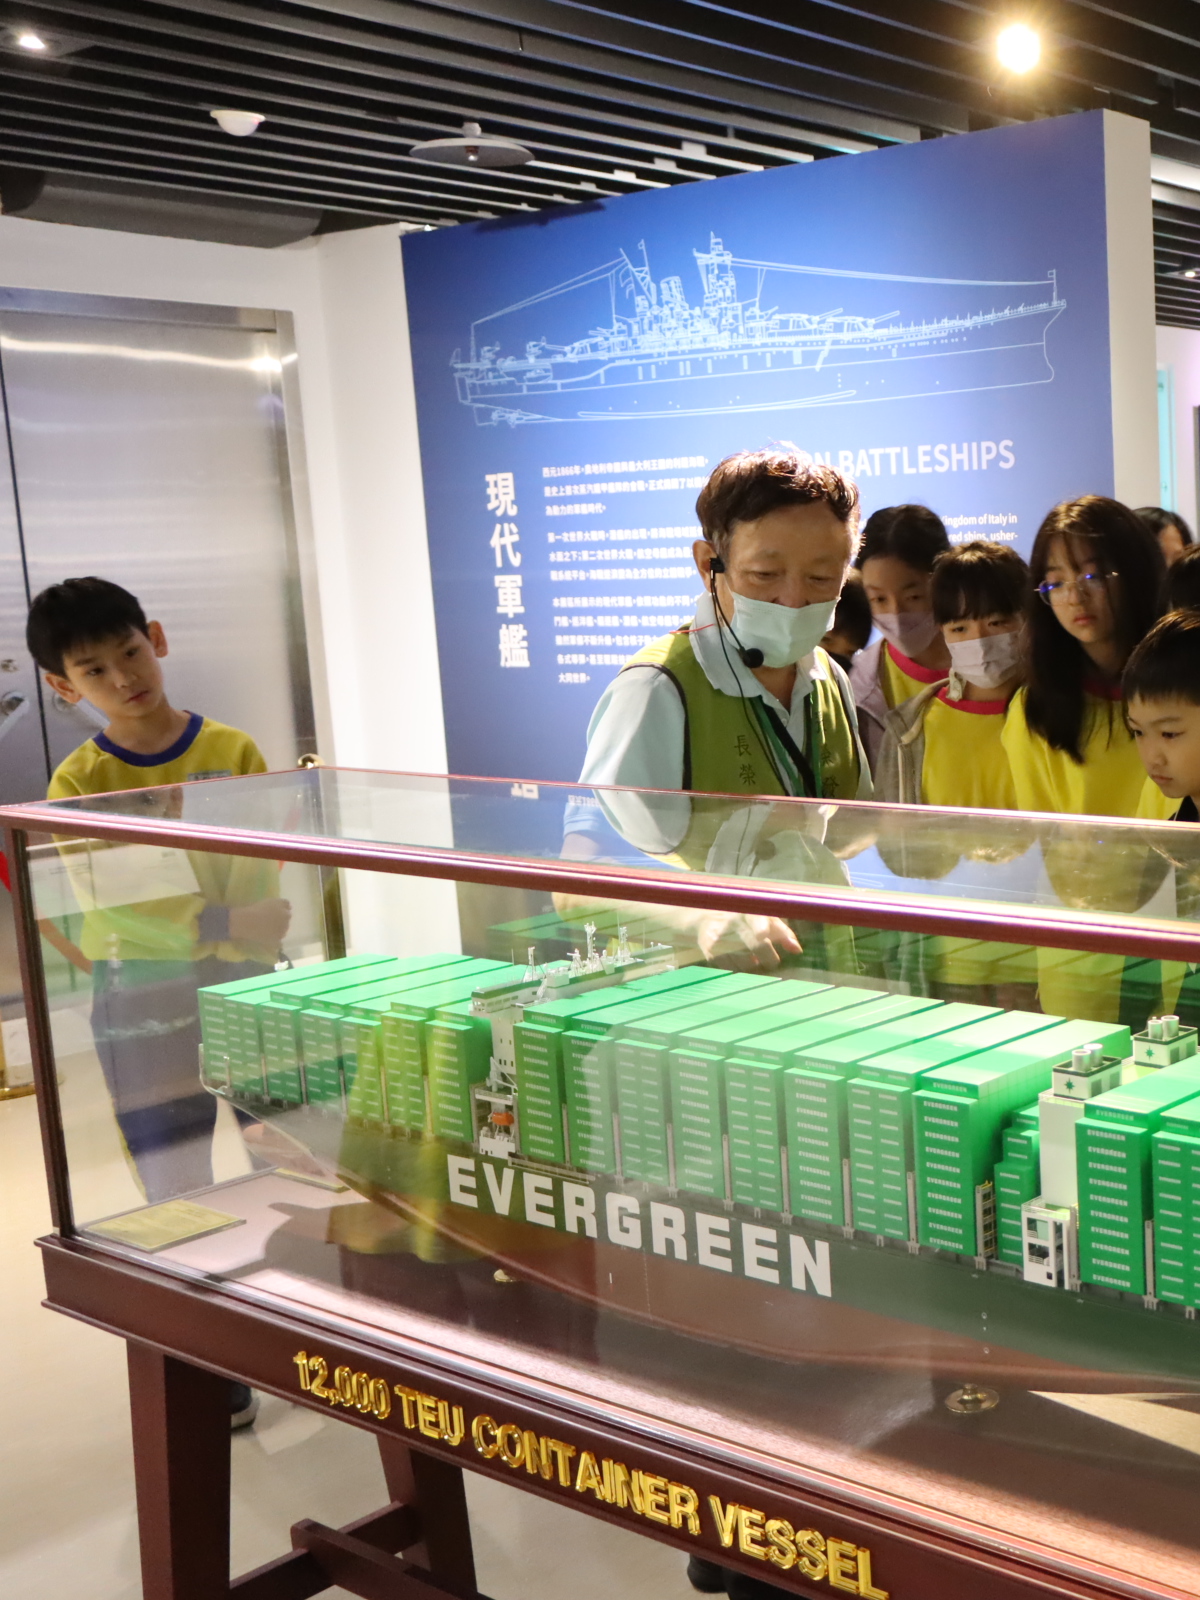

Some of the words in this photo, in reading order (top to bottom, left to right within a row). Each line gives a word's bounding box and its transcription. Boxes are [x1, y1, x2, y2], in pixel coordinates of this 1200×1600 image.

[839, 439, 1016, 478] BATTLESHIPS
[978, 513, 987, 525] of
[989, 513, 1007, 527] Italy
[1009, 513, 1018, 524] in
[990, 530, 1018, 541] usher-
[485, 472, 530, 668] 現代軍艦
[924, 1100, 959, 1111] EVERGREEN
[924, 1116, 958, 1127] EVERGREEN
[925, 1131, 959, 1142] EVERGREEN
[1087, 1129, 1126, 1141] EVERGREEN
[926, 1147, 960, 1158] EVERGREEN
[1088, 1146, 1126, 1158] EVERGREEN
[926, 1162, 960, 1173] EVERGREEN
[1089, 1162, 1127, 1173] EVERGREEN
[927, 1177, 961, 1188] EVERGREEN
[1089, 1178, 1127, 1190] EVERGREEN
[928, 1192, 962, 1203] EVERGREEN
[1090, 1194, 1128, 1206] EVERGREEN
[928, 1207, 962, 1219] EVERGREEN
[1091, 1210, 1128, 1223] EVERGREEN
[447, 1153, 833, 1297] EVERGREEN
[929, 1222, 962, 1234] EVERGREEN
[1091, 1227, 1129, 1239] EVERGREEN
[930, 1238, 963, 1250] EVERGREEN
[1092, 1242, 1129, 1255] EVERGREEN
[1092, 1258, 1130, 1271] EVERGREEN
[1093, 1274, 1131, 1287] EVERGREEN
[293, 1351, 390, 1420] 12,000
[395, 1384, 464, 1446] TEU
[471, 1414, 701, 1536] CONTAINER
[708, 1494, 890, 1600] VESSEL
